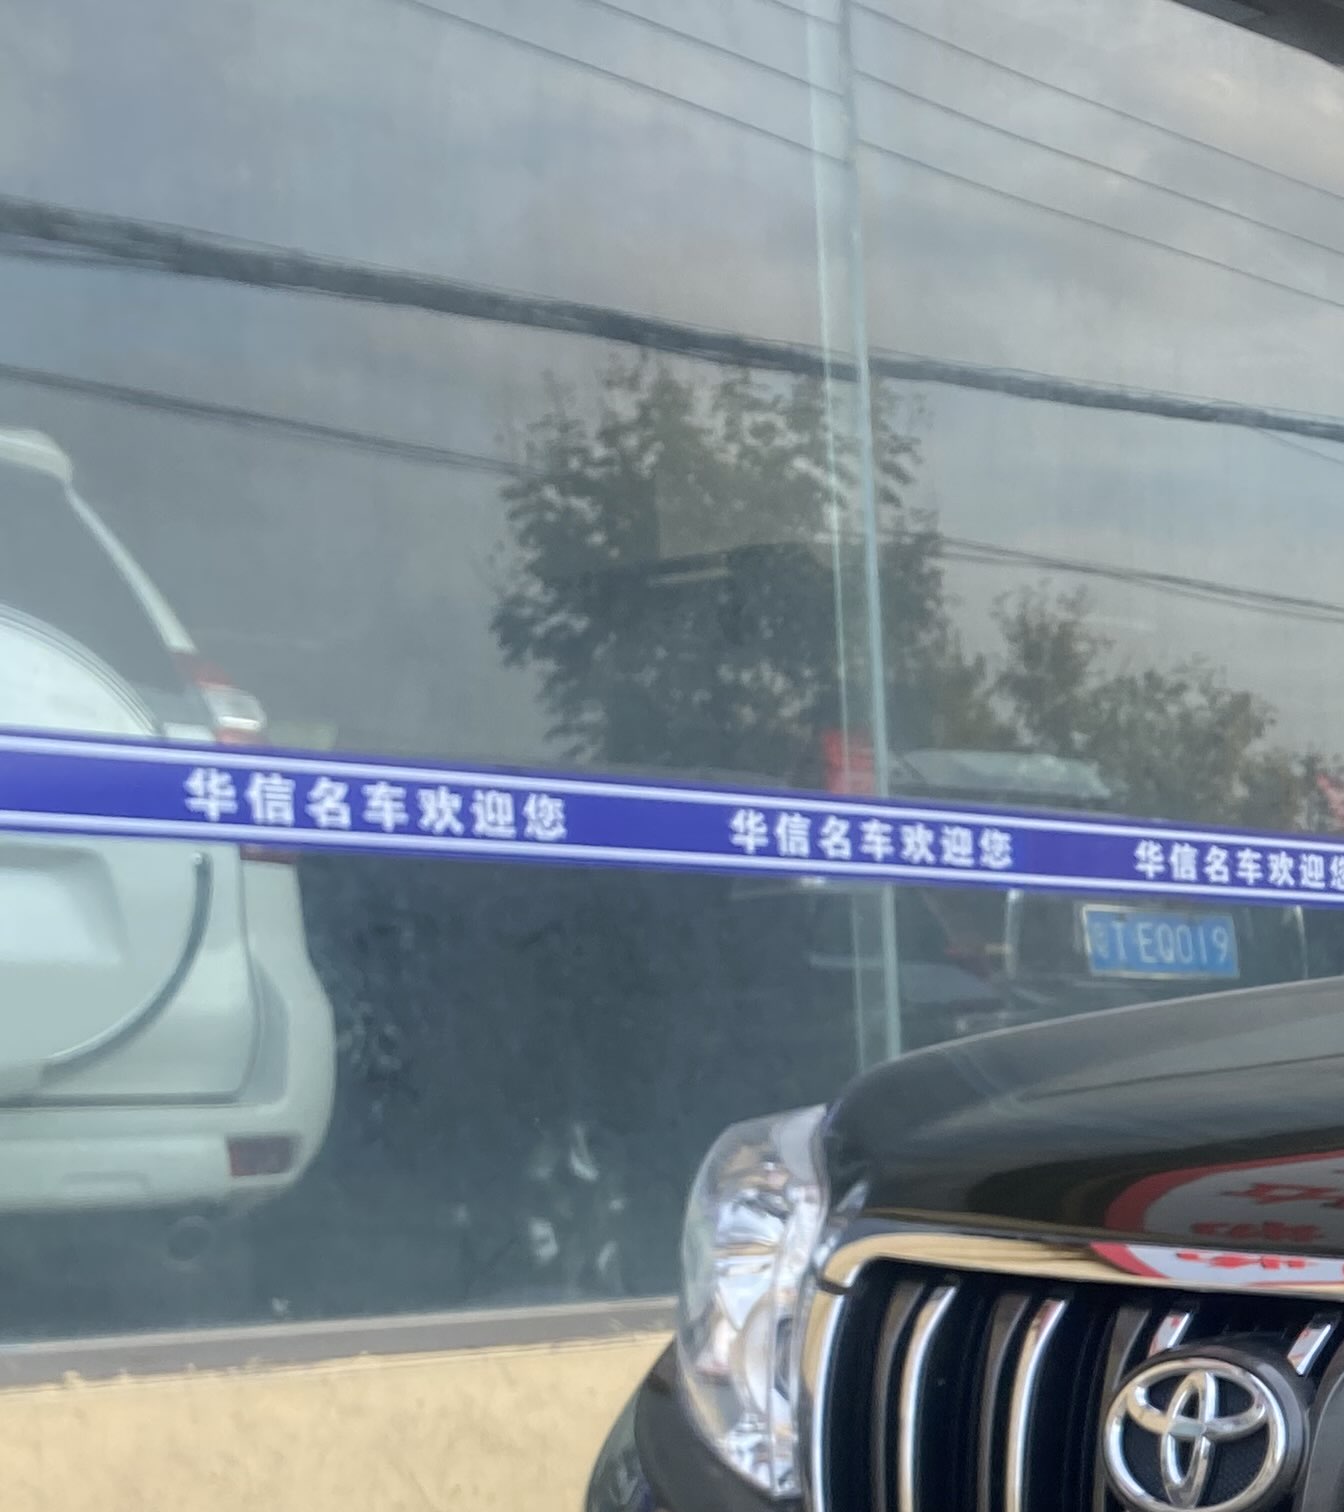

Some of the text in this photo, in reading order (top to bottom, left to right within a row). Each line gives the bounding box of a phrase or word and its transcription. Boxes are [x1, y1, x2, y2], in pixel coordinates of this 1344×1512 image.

[185, 767, 568, 842] 华信名车欢迎您
[728, 808, 1013, 870] 华信名车欢迎您
